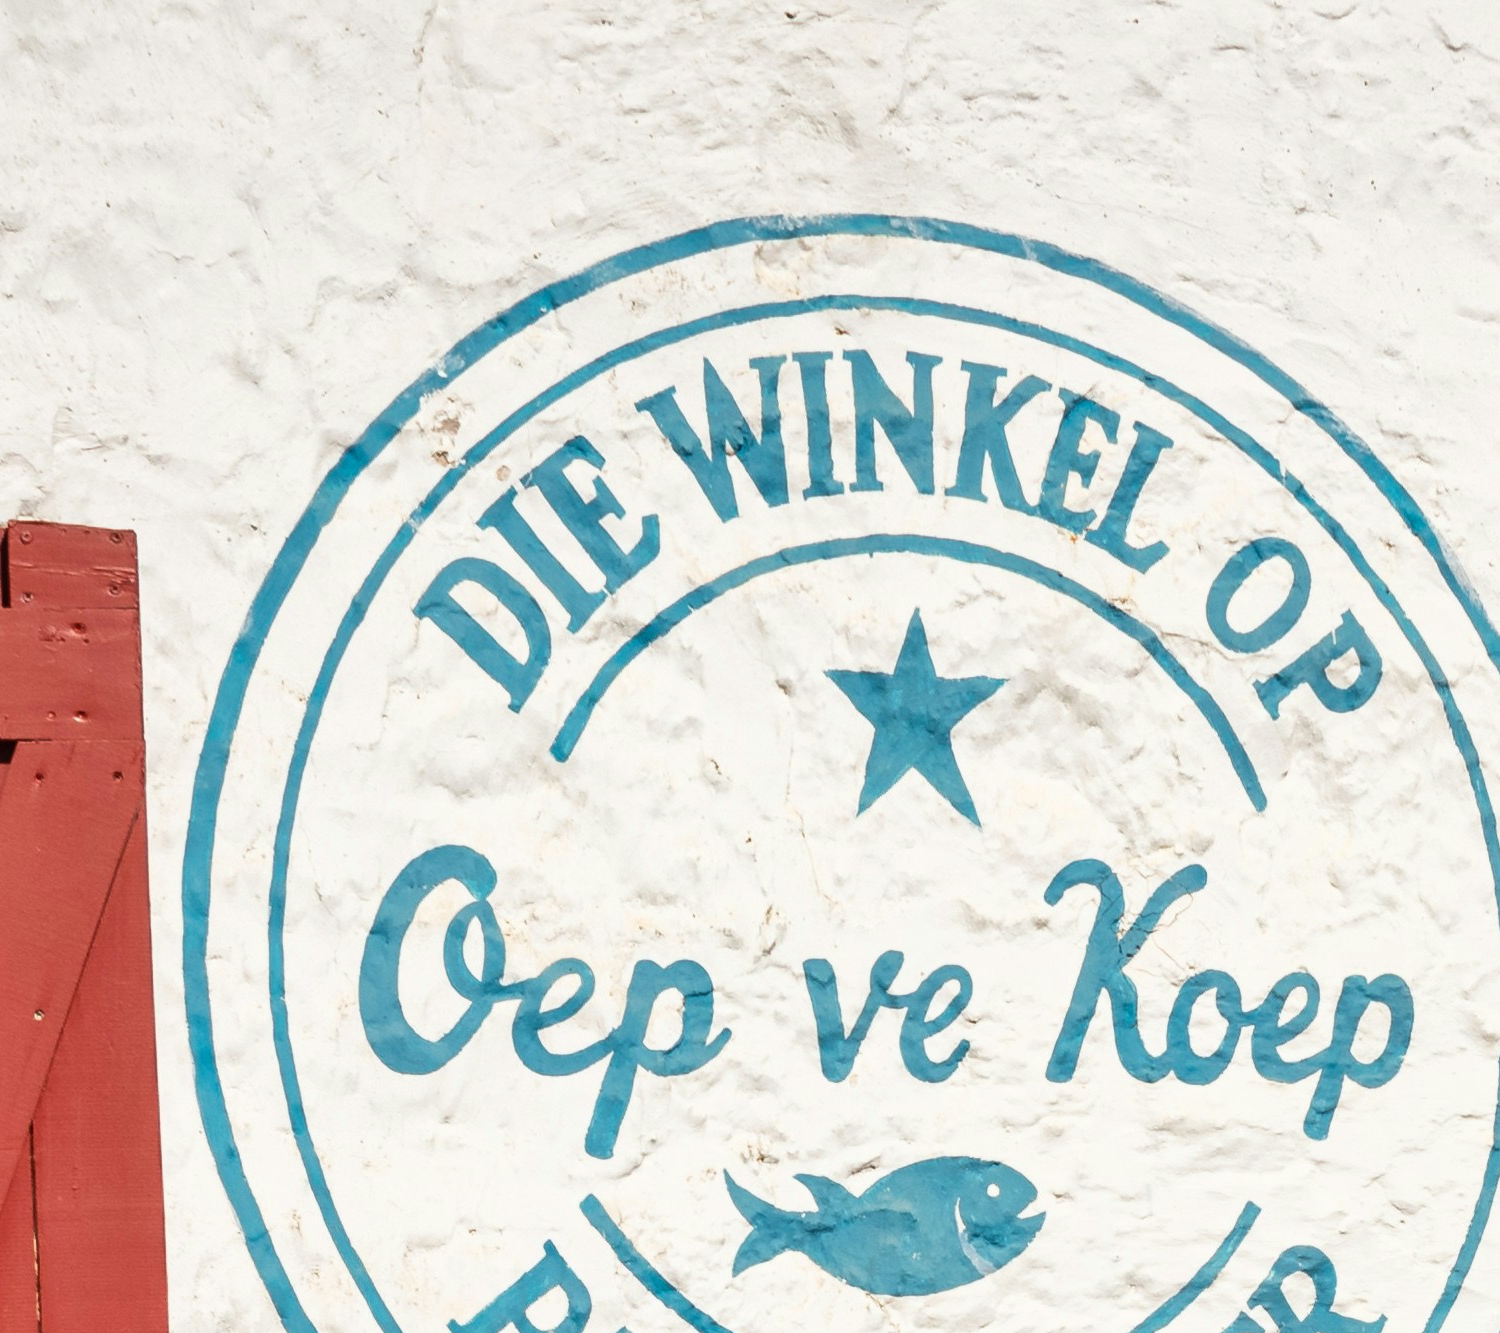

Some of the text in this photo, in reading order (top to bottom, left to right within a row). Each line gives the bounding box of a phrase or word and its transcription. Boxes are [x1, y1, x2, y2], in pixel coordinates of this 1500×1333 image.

[411, 349, 1382, 721] DIE WINKEL OP
[358, 843, 1413, 1158] Oep ve Koep
